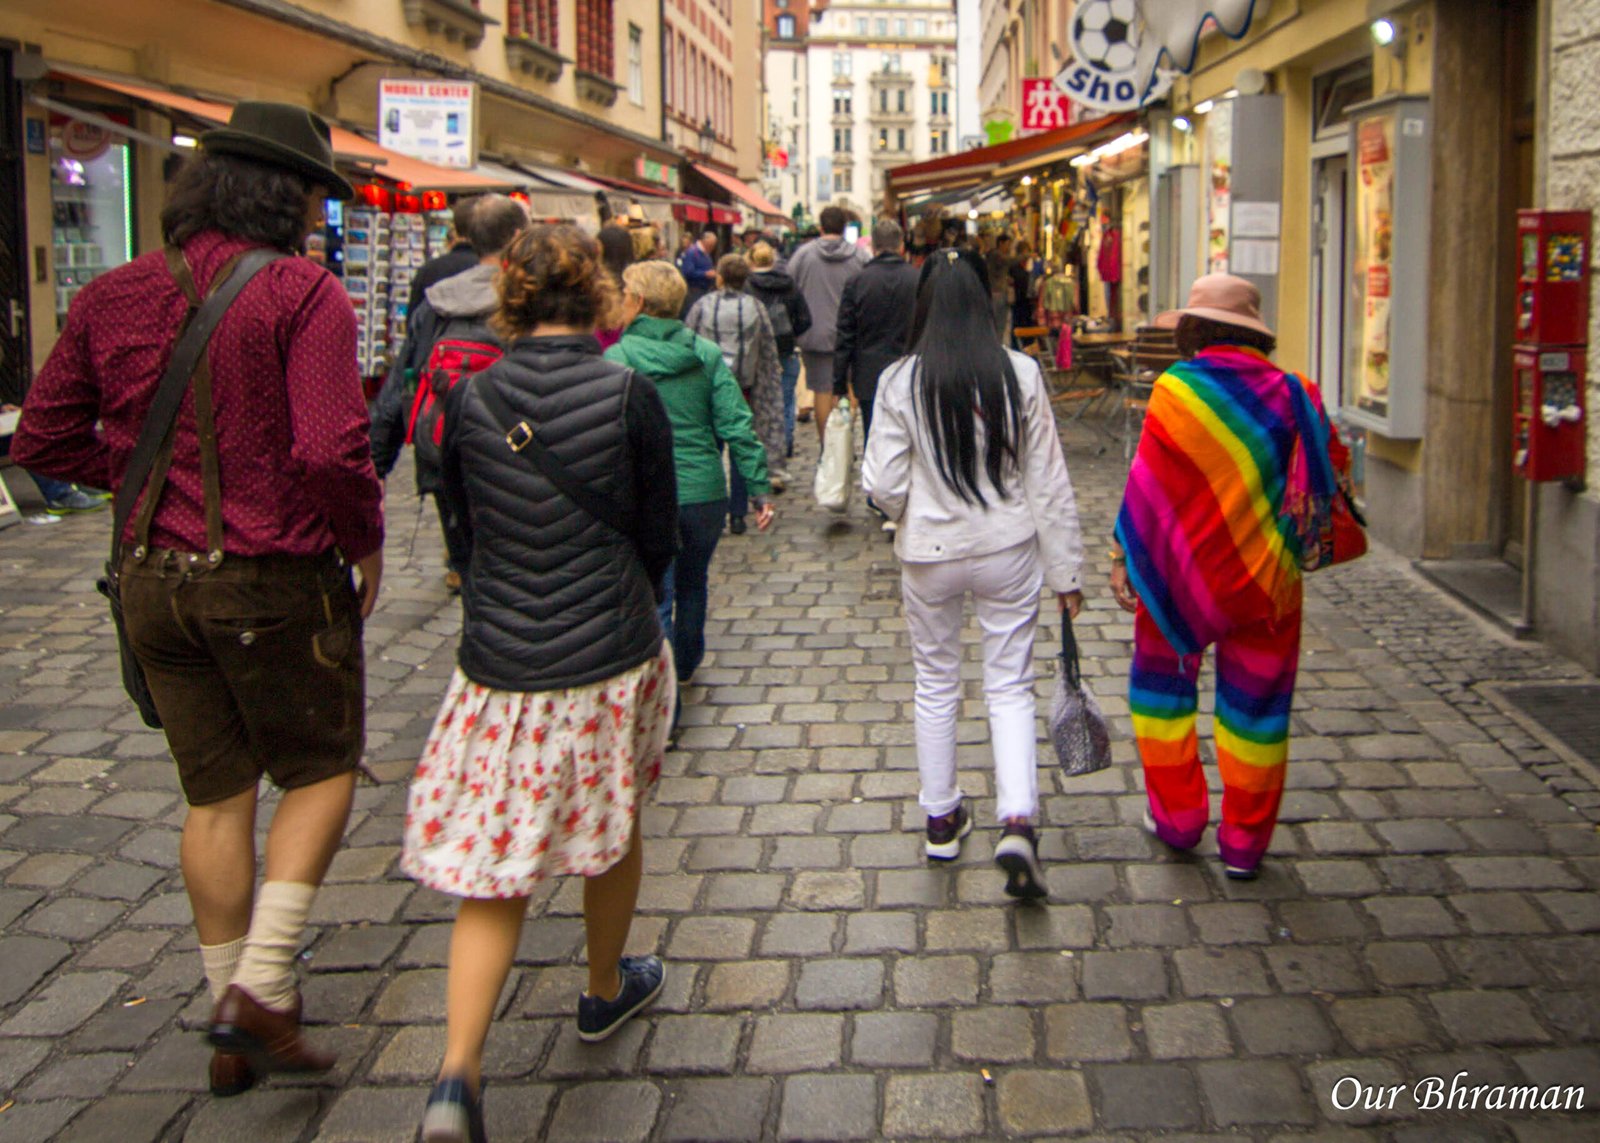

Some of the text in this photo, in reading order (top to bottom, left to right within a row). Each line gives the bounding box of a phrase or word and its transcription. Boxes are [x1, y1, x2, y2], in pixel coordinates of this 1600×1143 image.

[384, 84, 469, 98] MOBILE CENTER
[1066, 67, 1158, 102] Sho
